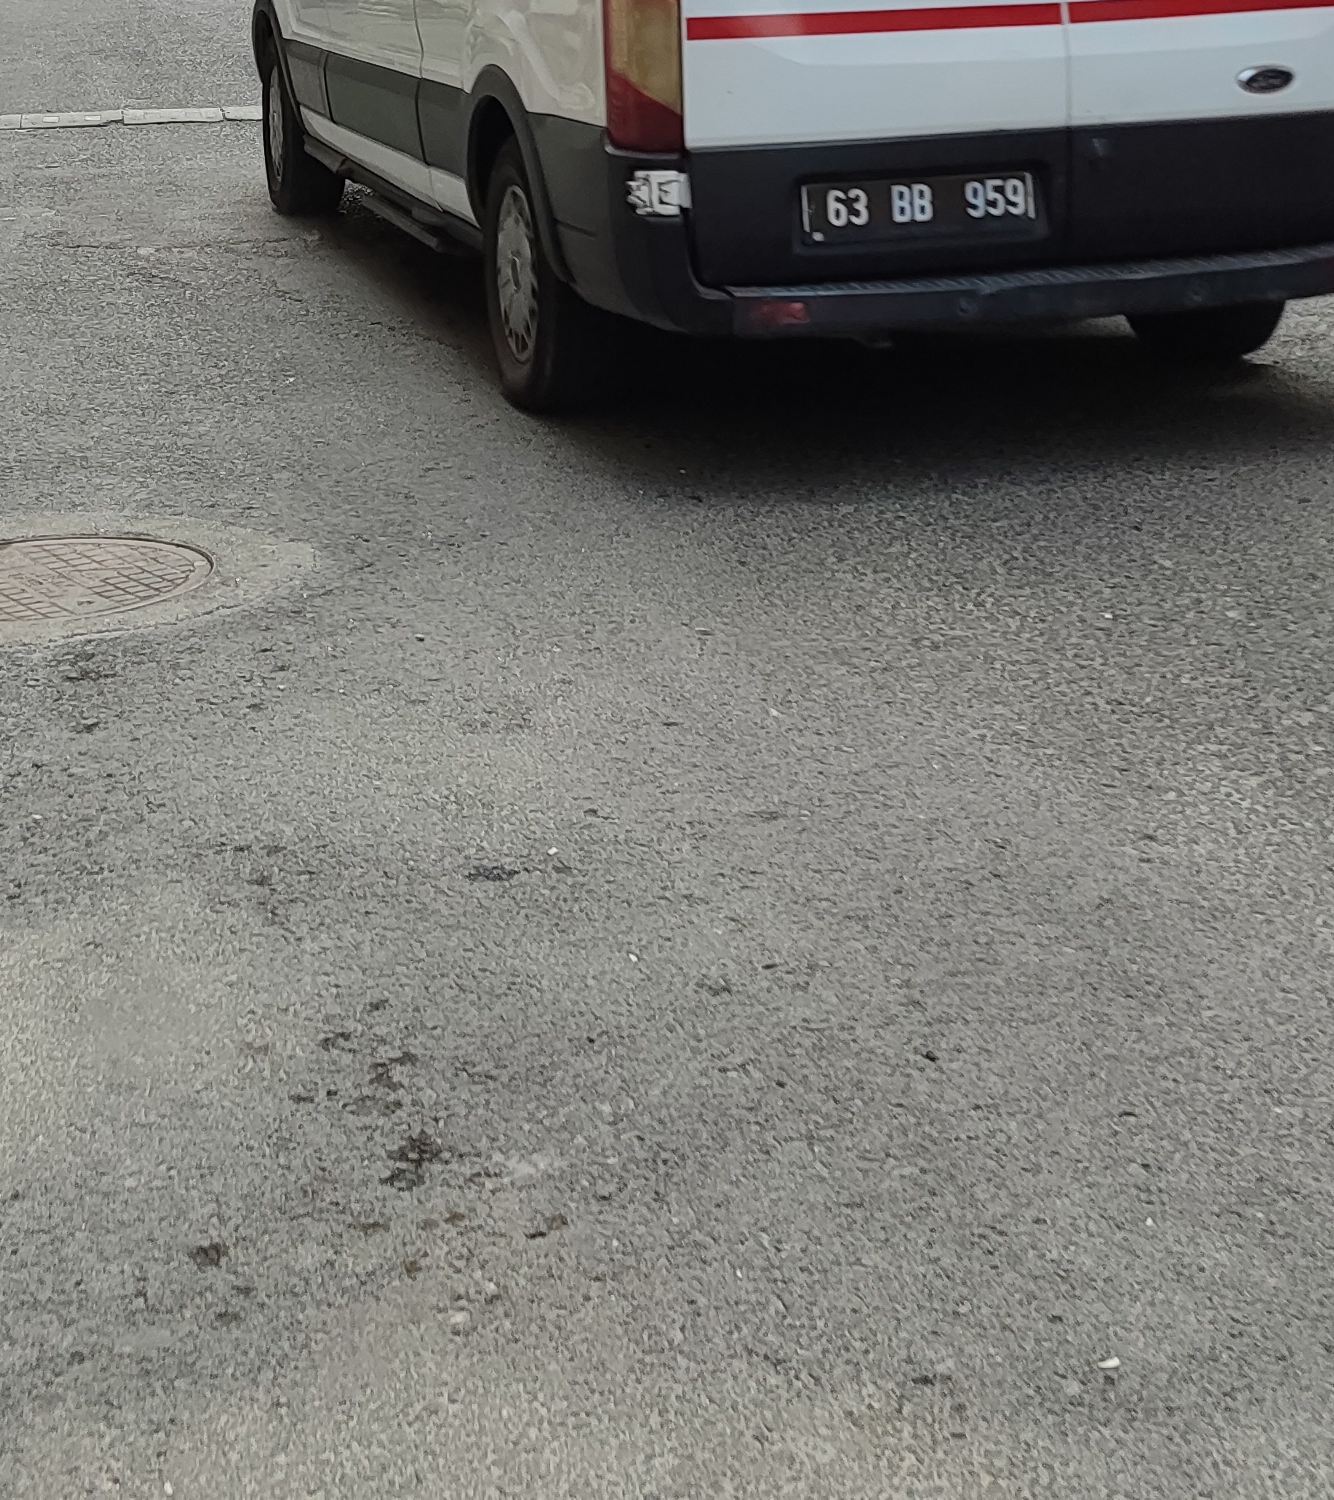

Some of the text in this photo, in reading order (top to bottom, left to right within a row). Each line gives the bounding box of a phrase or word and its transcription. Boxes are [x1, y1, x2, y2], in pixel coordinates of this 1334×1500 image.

[826, 178, 1026, 227] 63 BB 959
